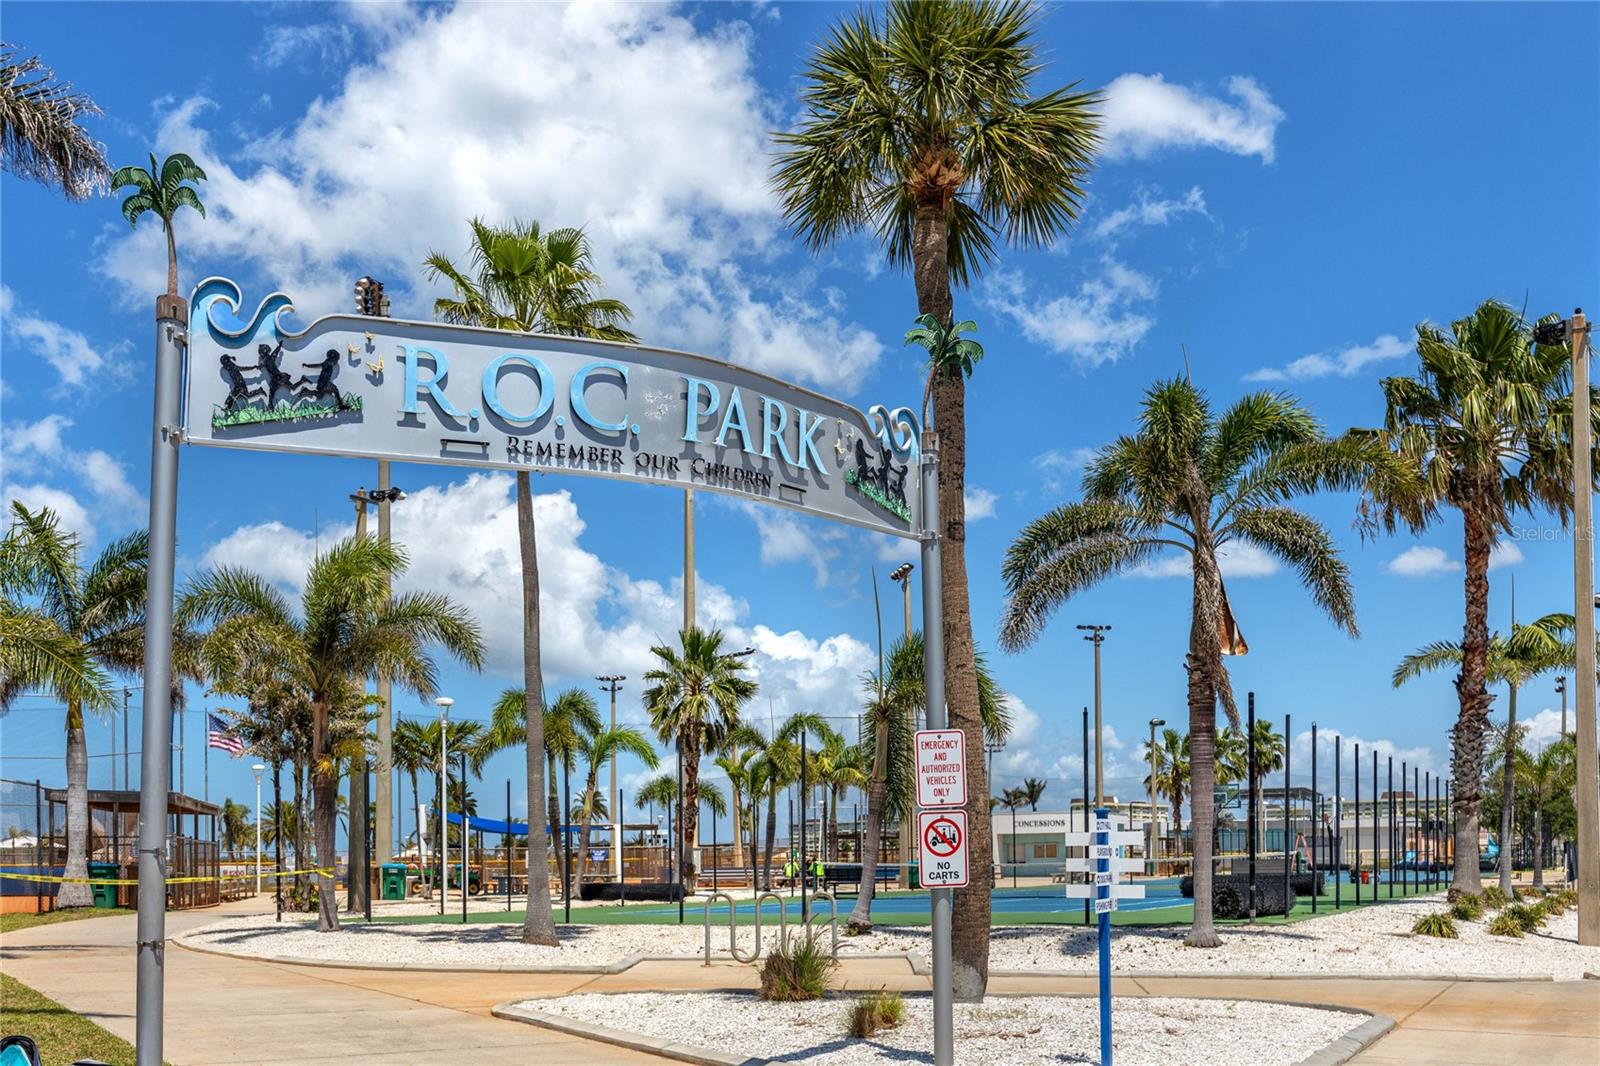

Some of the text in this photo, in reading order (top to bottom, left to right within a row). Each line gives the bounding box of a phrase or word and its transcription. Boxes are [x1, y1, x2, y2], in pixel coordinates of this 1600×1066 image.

[396, 344, 831, 476] R.O.C. PARK
[507, 436, 771, 488] REMEMBER OUR CHILDREN
[921, 740, 958, 750] EMERGENCY
[934, 752, 947, 761] AND
[921, 763, 960, 774] AUTHORIZED
[926, 776, 957, 786] VEHICLES
[933, 788, 950, 797] ONLY
[937, 861, 951, 870] NO
[928, 871, 960, 880] CARTS
